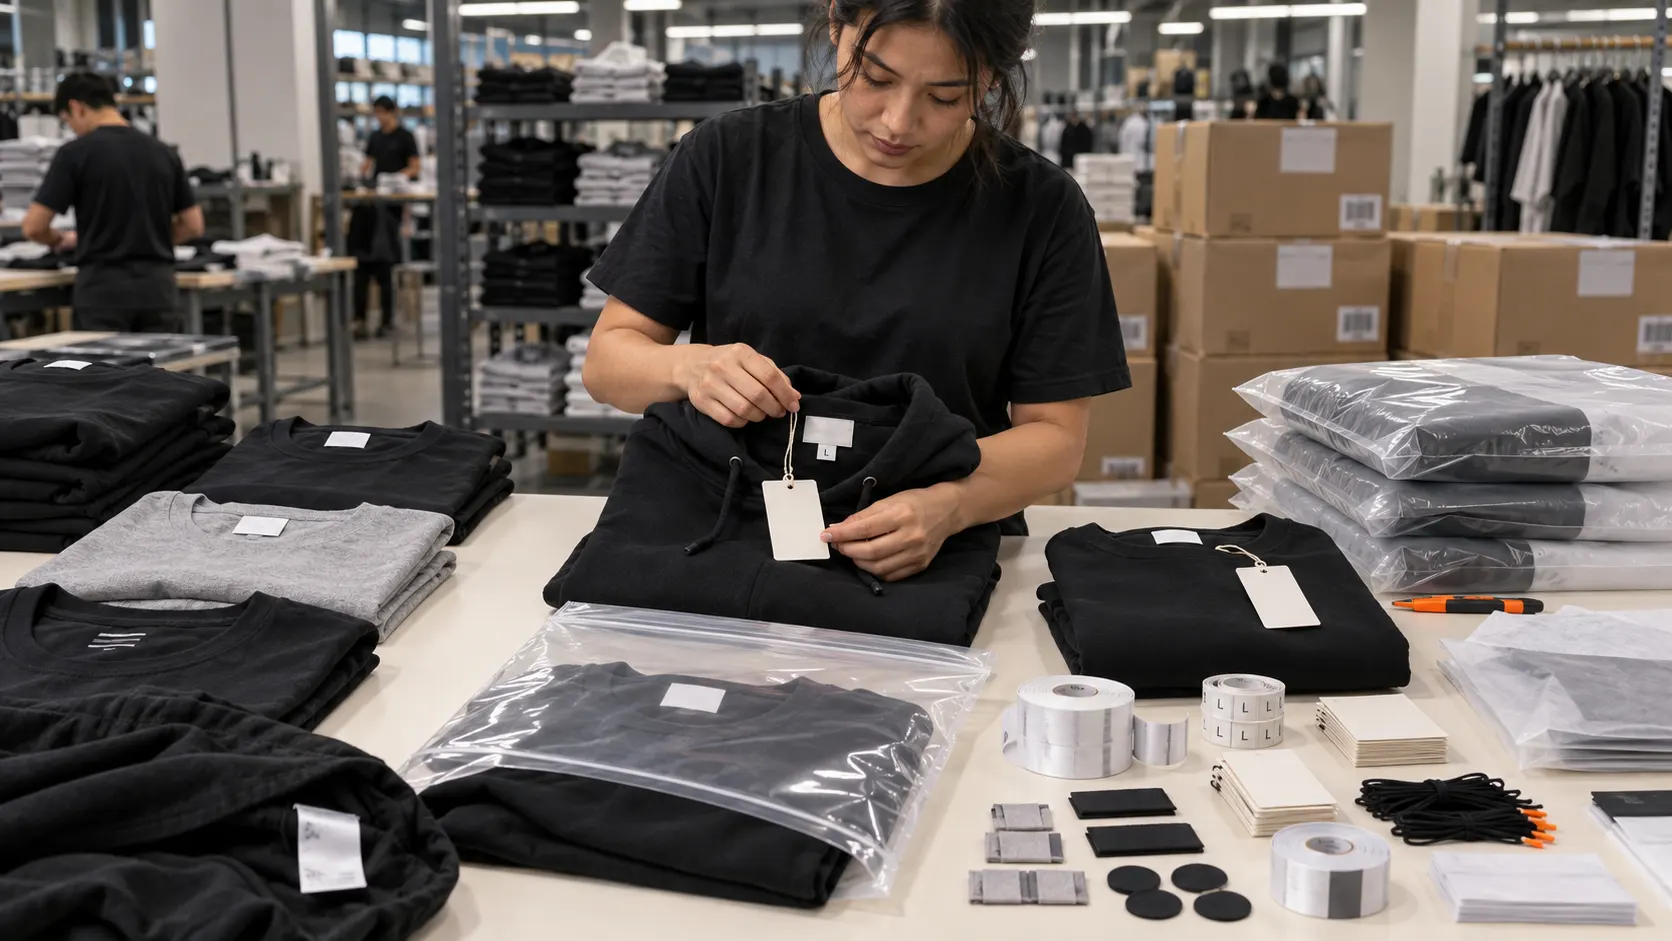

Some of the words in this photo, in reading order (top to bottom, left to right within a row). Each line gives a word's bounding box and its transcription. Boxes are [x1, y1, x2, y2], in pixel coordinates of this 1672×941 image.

[824, 448, 829, 457] L
[1217, 698, 1224, 710] L
[1242, 702, 1249, 713] L
[1266, 700, 1272, 712] L
[1216, 726, 1223, 738] L
[1241, 730, 1248, 741] L
[1265, 729, 1271, 740] L
